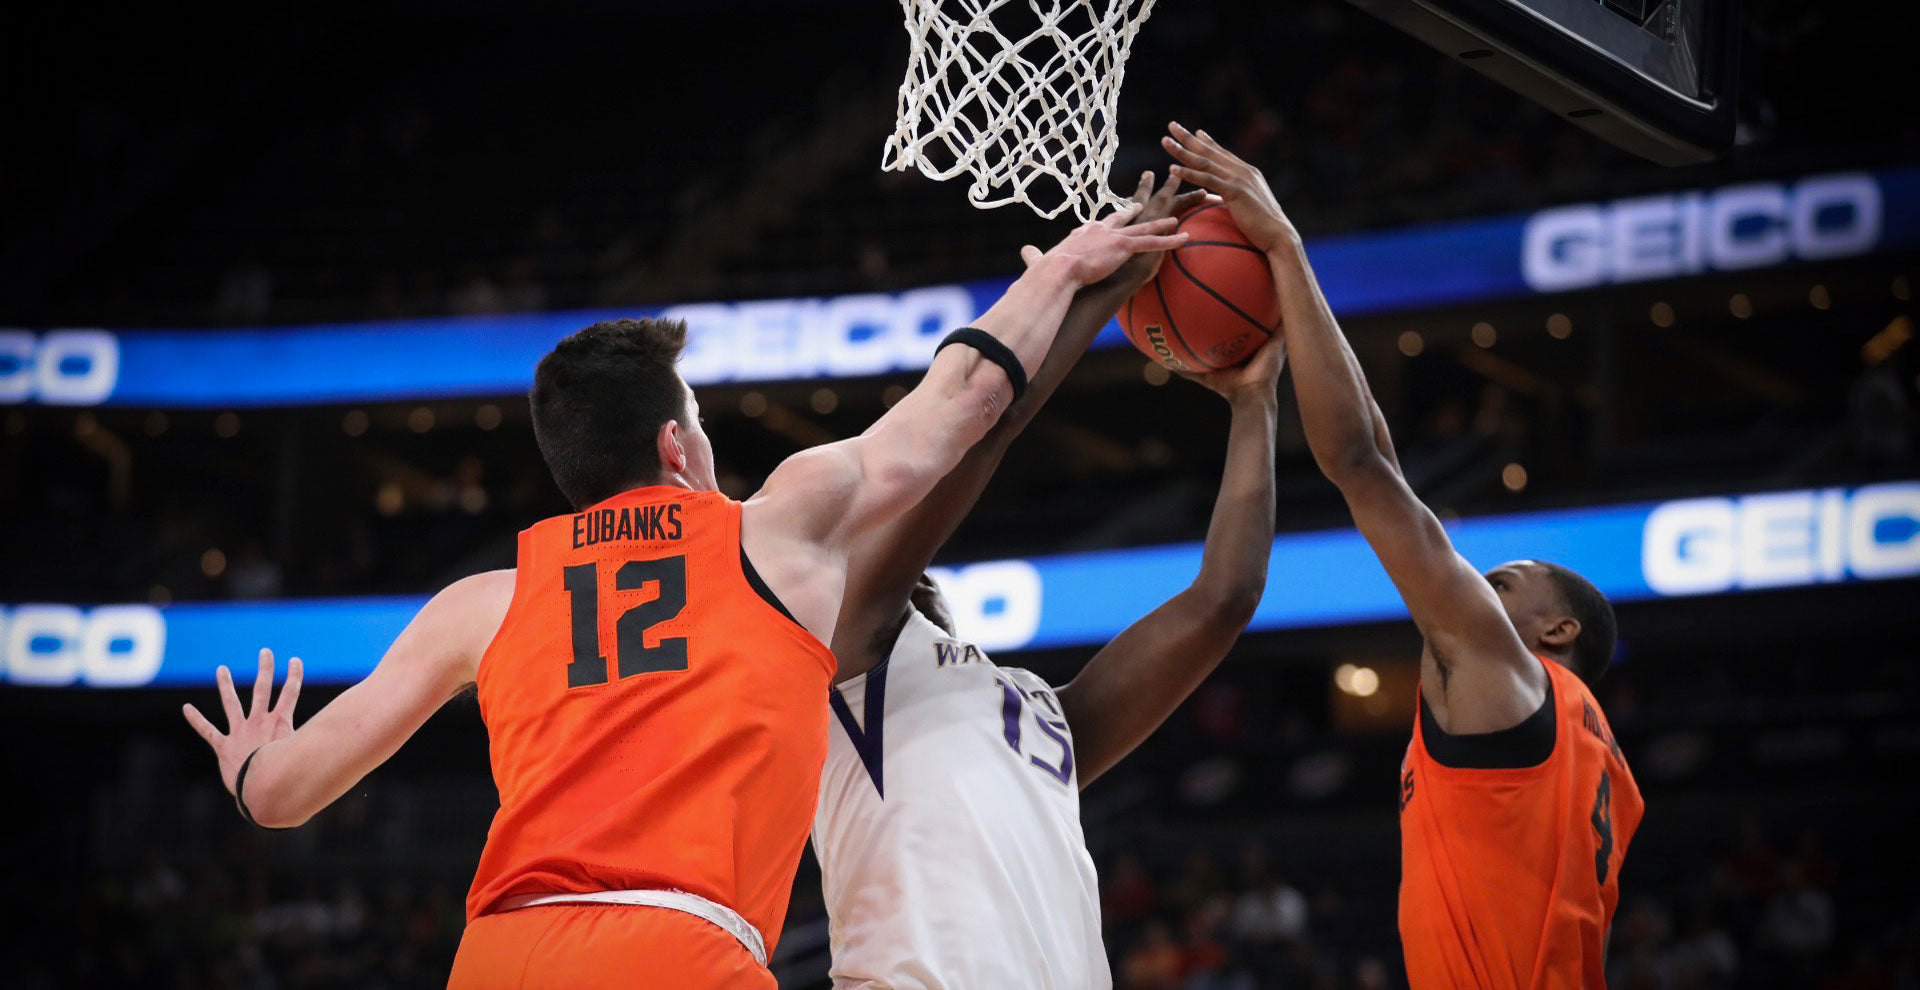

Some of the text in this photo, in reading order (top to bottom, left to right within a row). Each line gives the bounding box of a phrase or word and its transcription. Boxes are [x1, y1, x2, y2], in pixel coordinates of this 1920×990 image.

[1521, 171, 1882, 292] GEICO
[658, 285, 975, 385] GEICO
[573, 503, 682, 550] EUBANKS
[0, 603, 167, 688] CO
[563, 554, 689, 689] 12
[995, 677, 1073, 786] 15
[1591, 769, 1614, 887] 4
